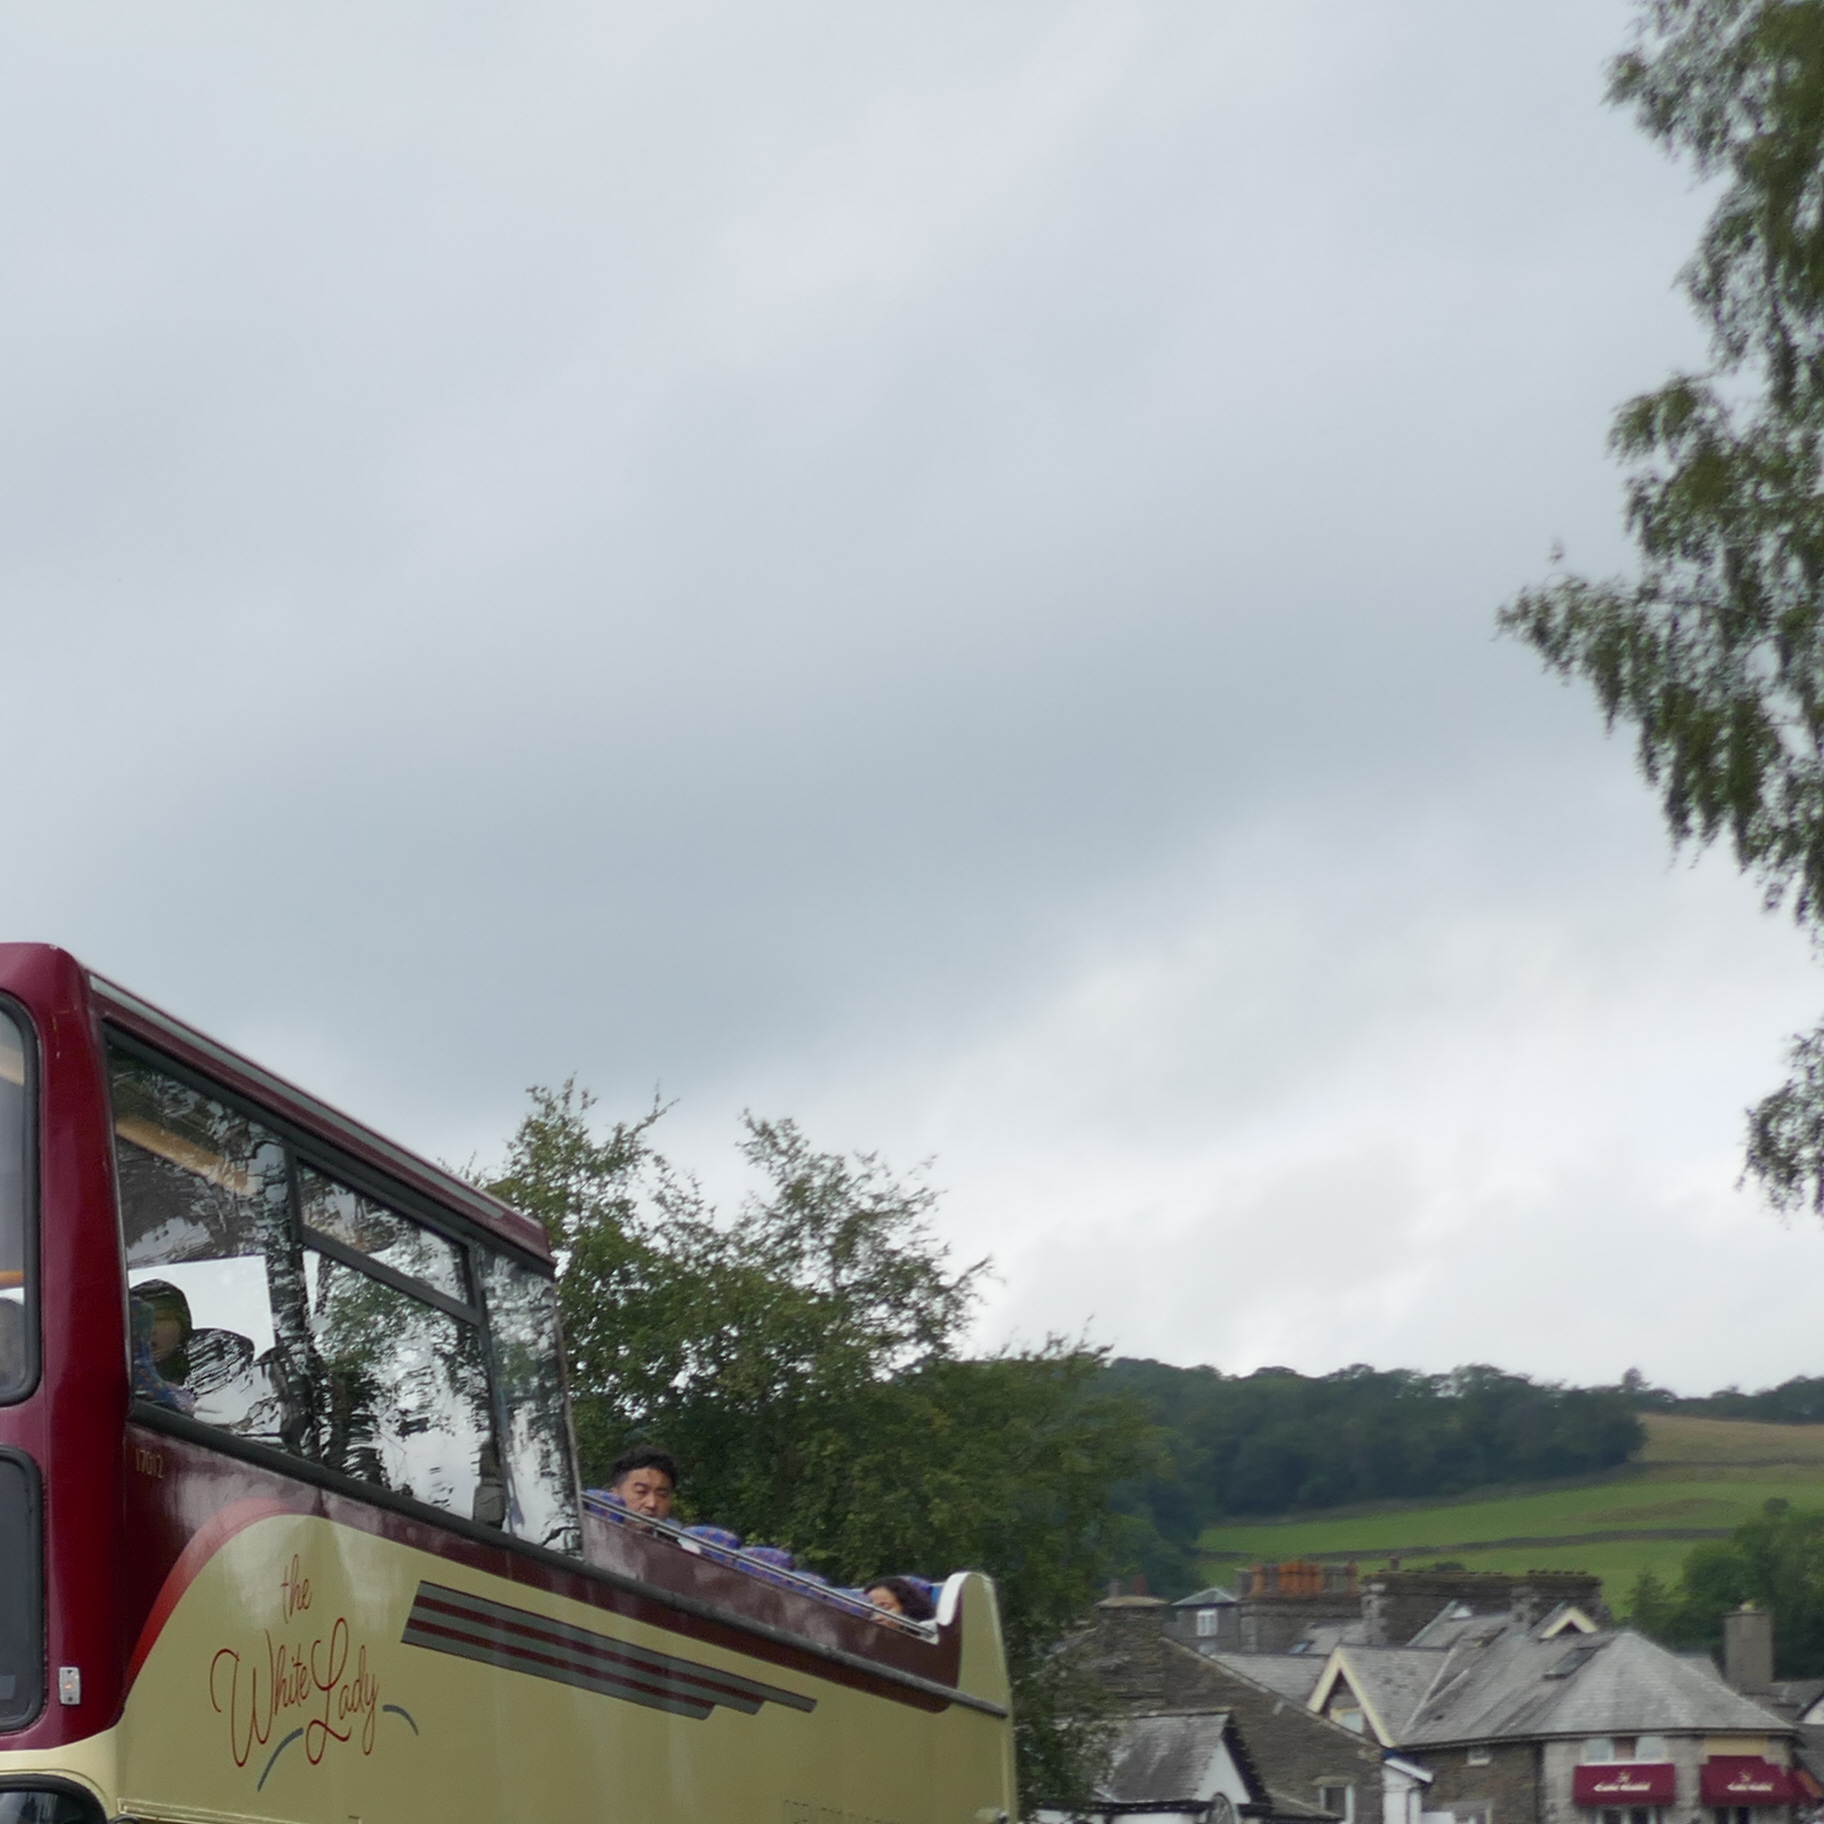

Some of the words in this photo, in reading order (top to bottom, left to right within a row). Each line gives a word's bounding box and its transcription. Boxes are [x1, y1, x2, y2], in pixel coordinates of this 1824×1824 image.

[280, 1553, 312, 1625] the
[209, 1629, 314, 1768] White
[304, 1617, 380, 1766] Lady
